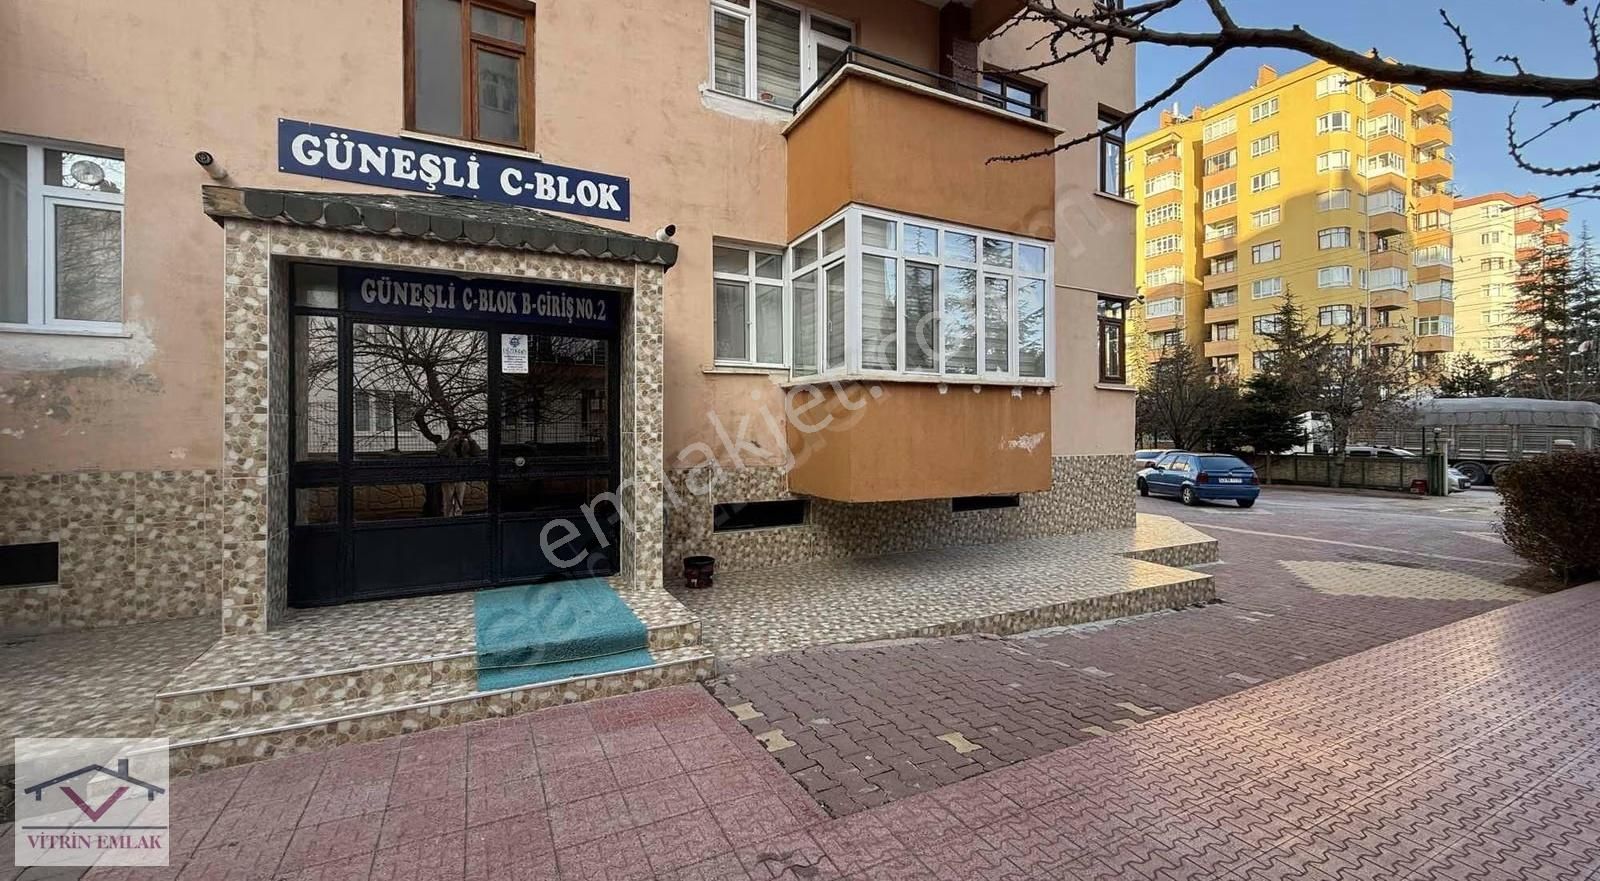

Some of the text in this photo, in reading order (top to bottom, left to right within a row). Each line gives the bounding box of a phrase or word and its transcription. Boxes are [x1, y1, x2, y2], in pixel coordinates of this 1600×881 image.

[291, 132, 622, 212] GÜNEŞLİ C-BLOK
[360, 276, 606, 324] GÜNEŞLİ C-BLOK B-GİRİŞ NO.2
